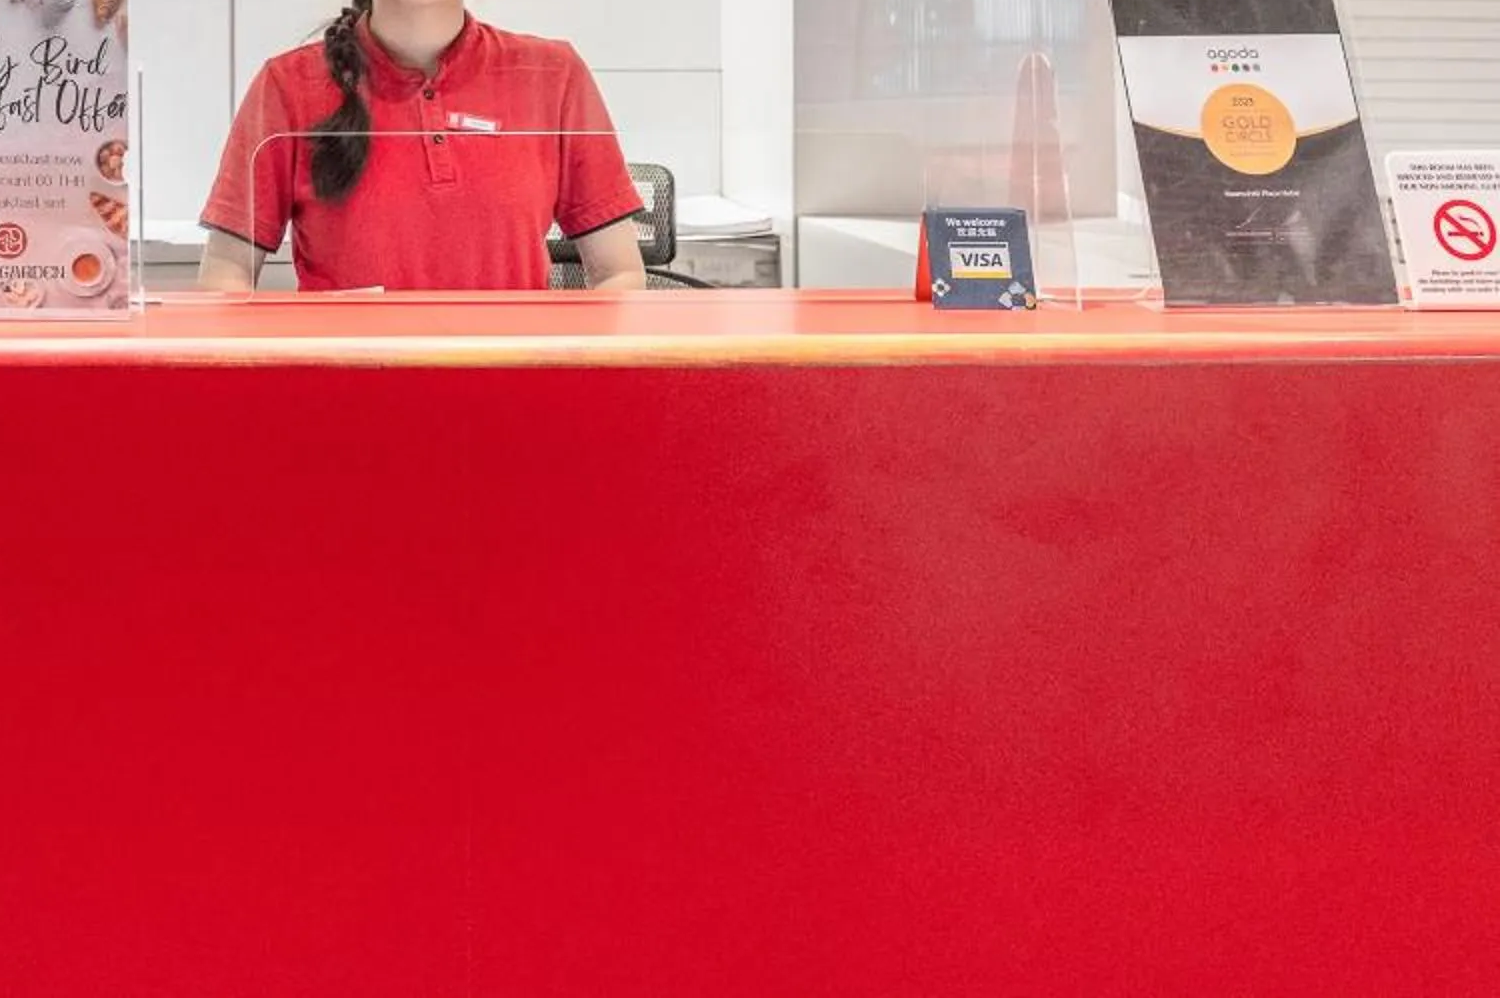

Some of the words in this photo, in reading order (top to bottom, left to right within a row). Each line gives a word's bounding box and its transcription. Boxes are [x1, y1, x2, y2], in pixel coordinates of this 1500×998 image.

[30, 36, 108, 85] Bird
[1207, 48, 1260, 62] agoda
[1222, 115, 1272, 130] GOLD
[963, 217, 1005, 227] welcome
[960, 253, 1004, 267] VISA
[0, 265, 65, 279] GARDEN
